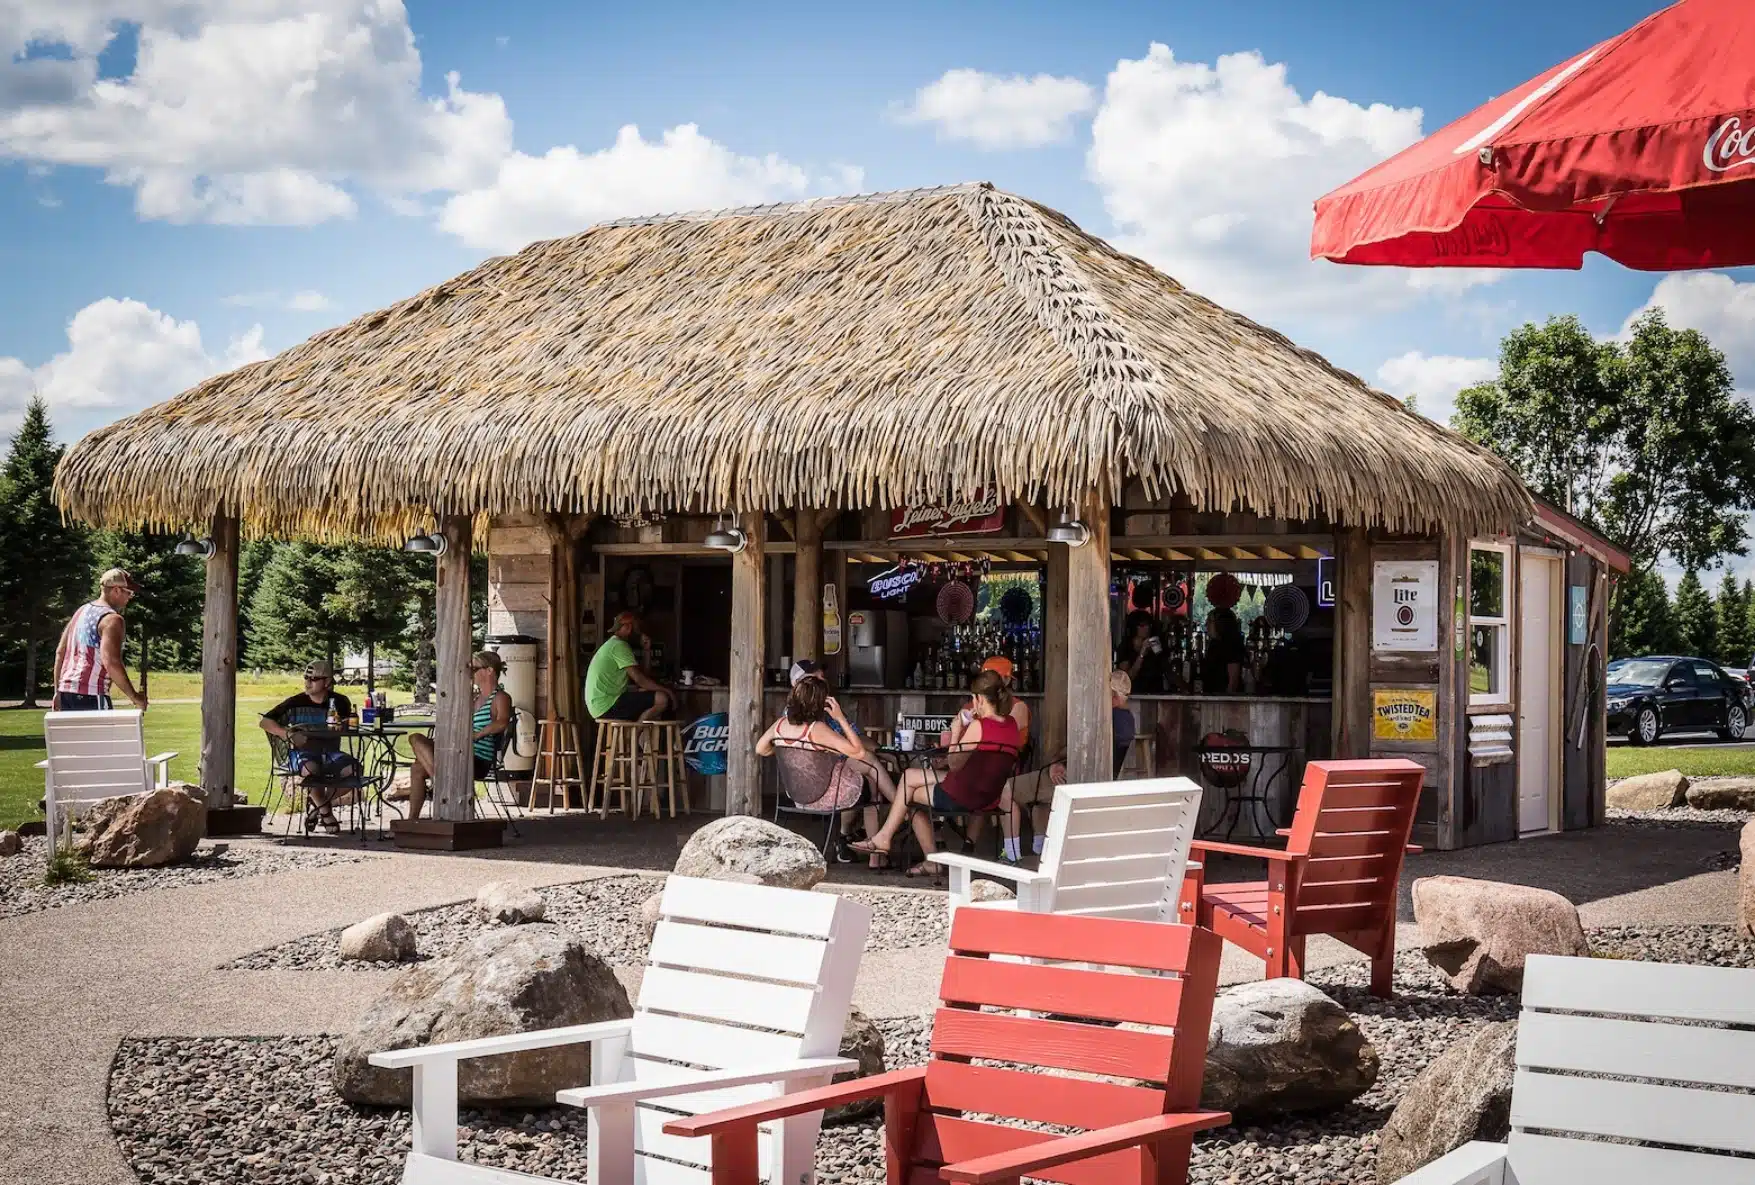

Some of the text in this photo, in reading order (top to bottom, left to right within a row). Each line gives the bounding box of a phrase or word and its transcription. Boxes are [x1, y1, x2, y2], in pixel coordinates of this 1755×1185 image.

[881, 585, 911, 599] LIGHT
[1394, 589, 1418, 605] Lite
[1377, 704, 1430, 719] TWISTED TEA
[906, 719, 949, 731] BAD BOYS
[684, 739, 729, 754] LIGH
